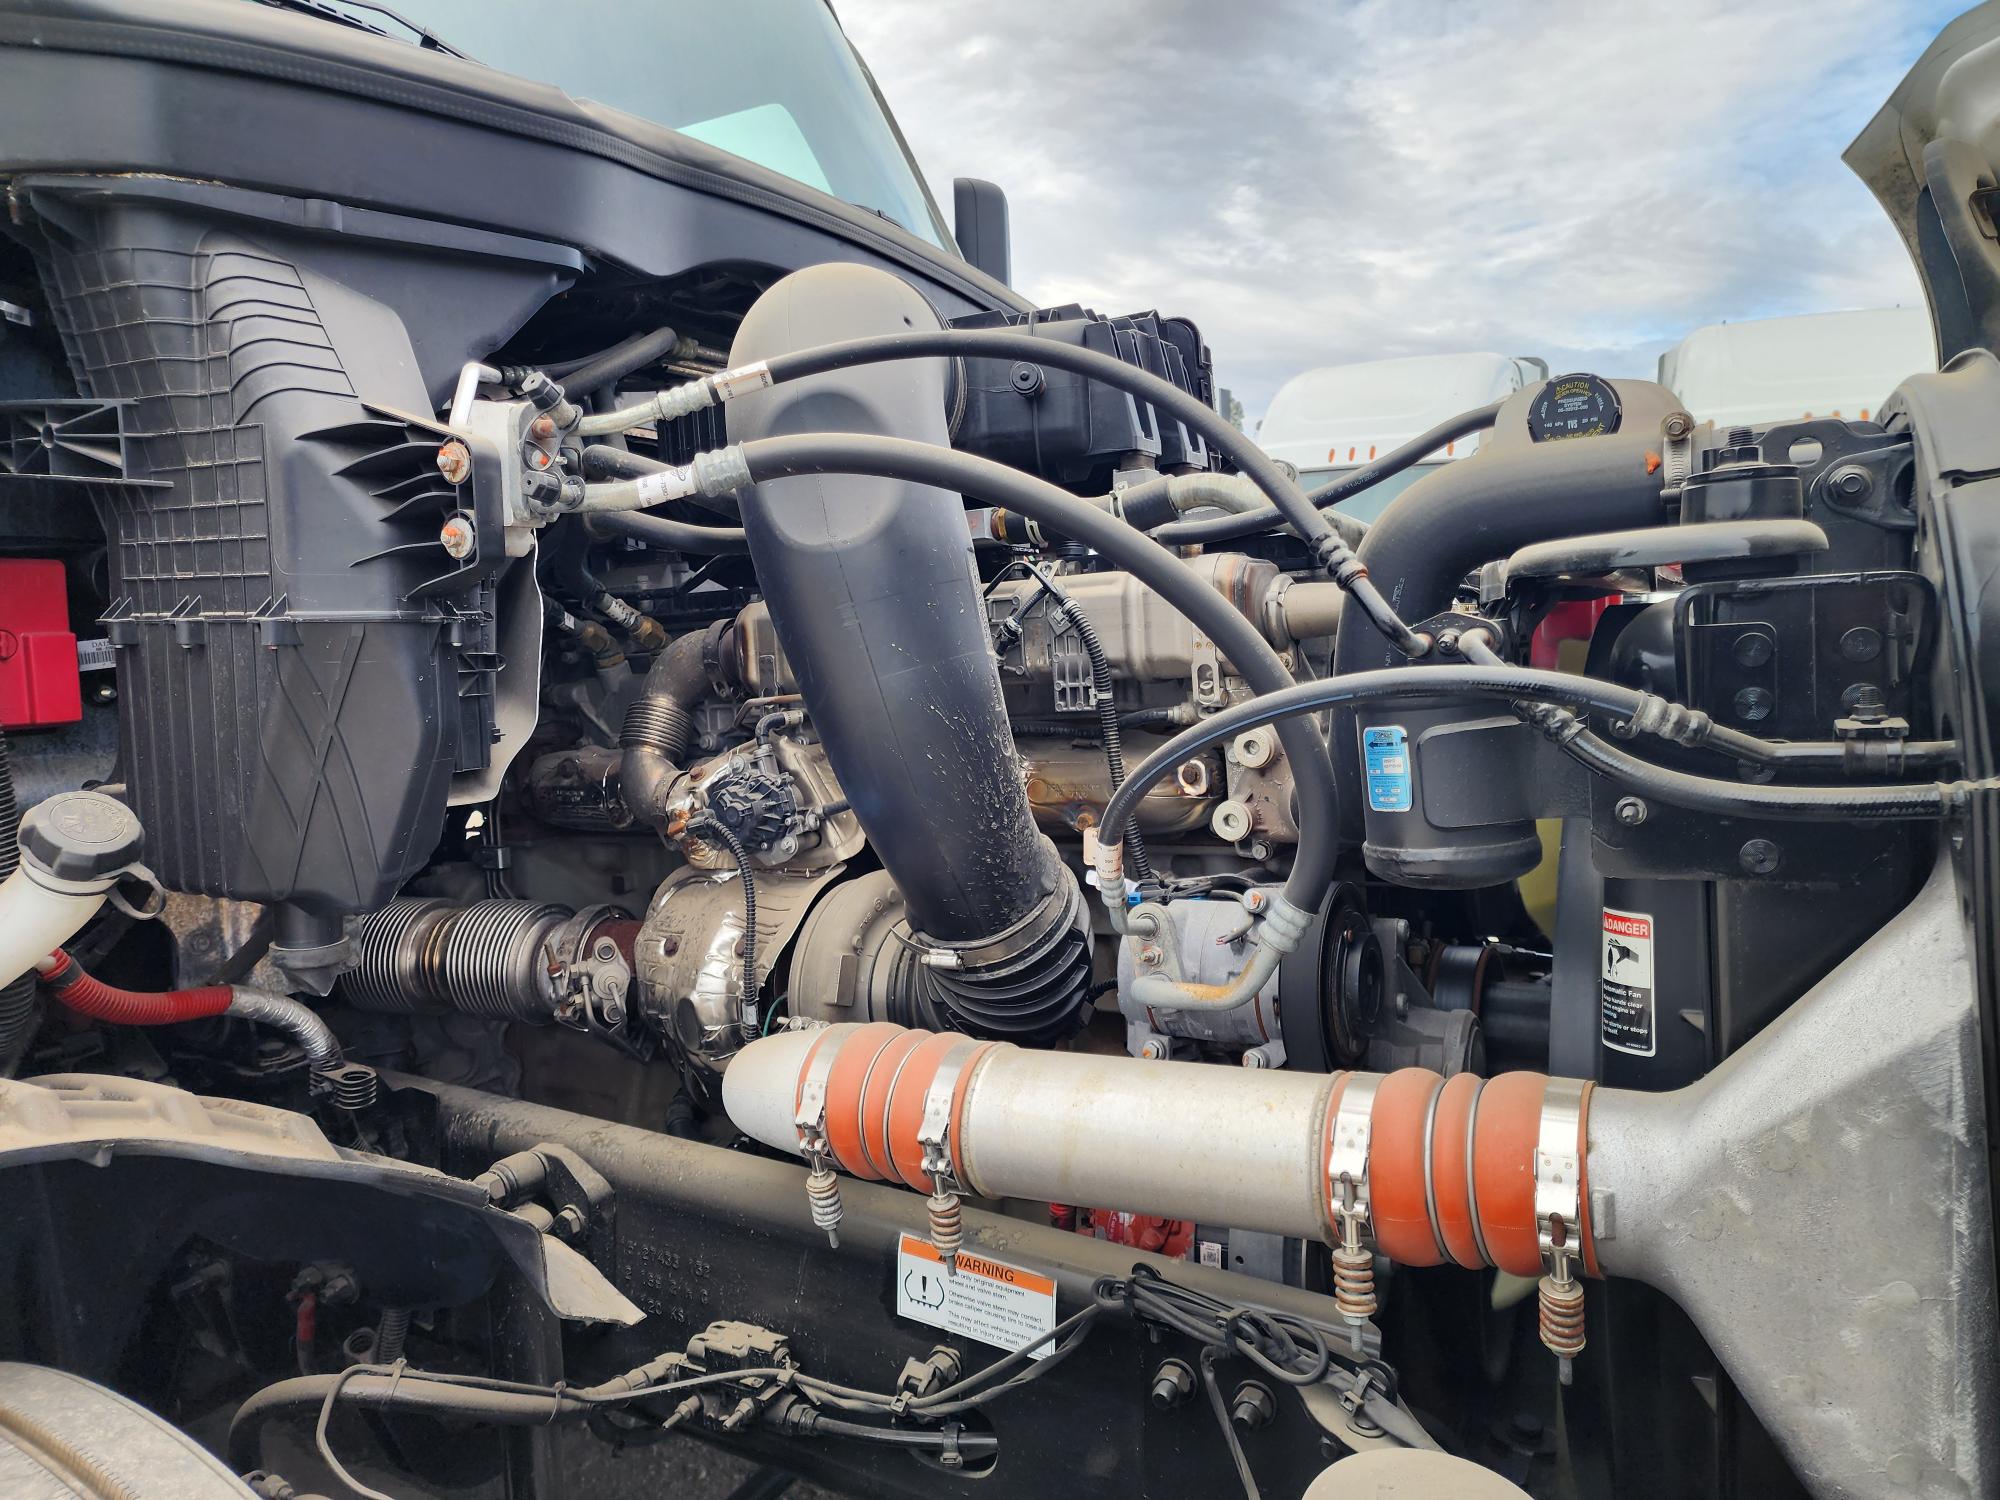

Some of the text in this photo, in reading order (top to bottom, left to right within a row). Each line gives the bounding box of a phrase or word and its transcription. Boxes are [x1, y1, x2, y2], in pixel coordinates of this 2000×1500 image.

[1561, 381, 1590, 390] CAUTION
[1607, 919, 1648, 936] DANGER
[1612, 997, 1626, 1006] hands
[1628, 990, 1642, 998] Fan
[1612, 1006, 1628, 1014] engine
[1609, 1022, 1622, 1030] starts
[1630, 1026, 1648, 1035] stops
[955, 1255, 1014, 1283] WARNING
[949, 1279, 964, 1288] wheel
[976, 1287, 991, 1295] valve
[960, 1274, 973, 1282] only
[974, 1276, 994, 1288] original
[995, 1282, 1024, 1297] equipment
[949, 1290, 1042, 1324] Otherwise valve stem may contact
[949, 1298, 964, 1308] brake
[964, 1302, 982, 1314] caliper
[984, 1309, 1006, 1322] causing
[1024, 1321, 1038, 1330] lose
[948, 1310, 1032, 1342] This may affect vehicle control
[948, 1320, 972, 1332] resulting
[980, 1328, 995, 1342] injury
